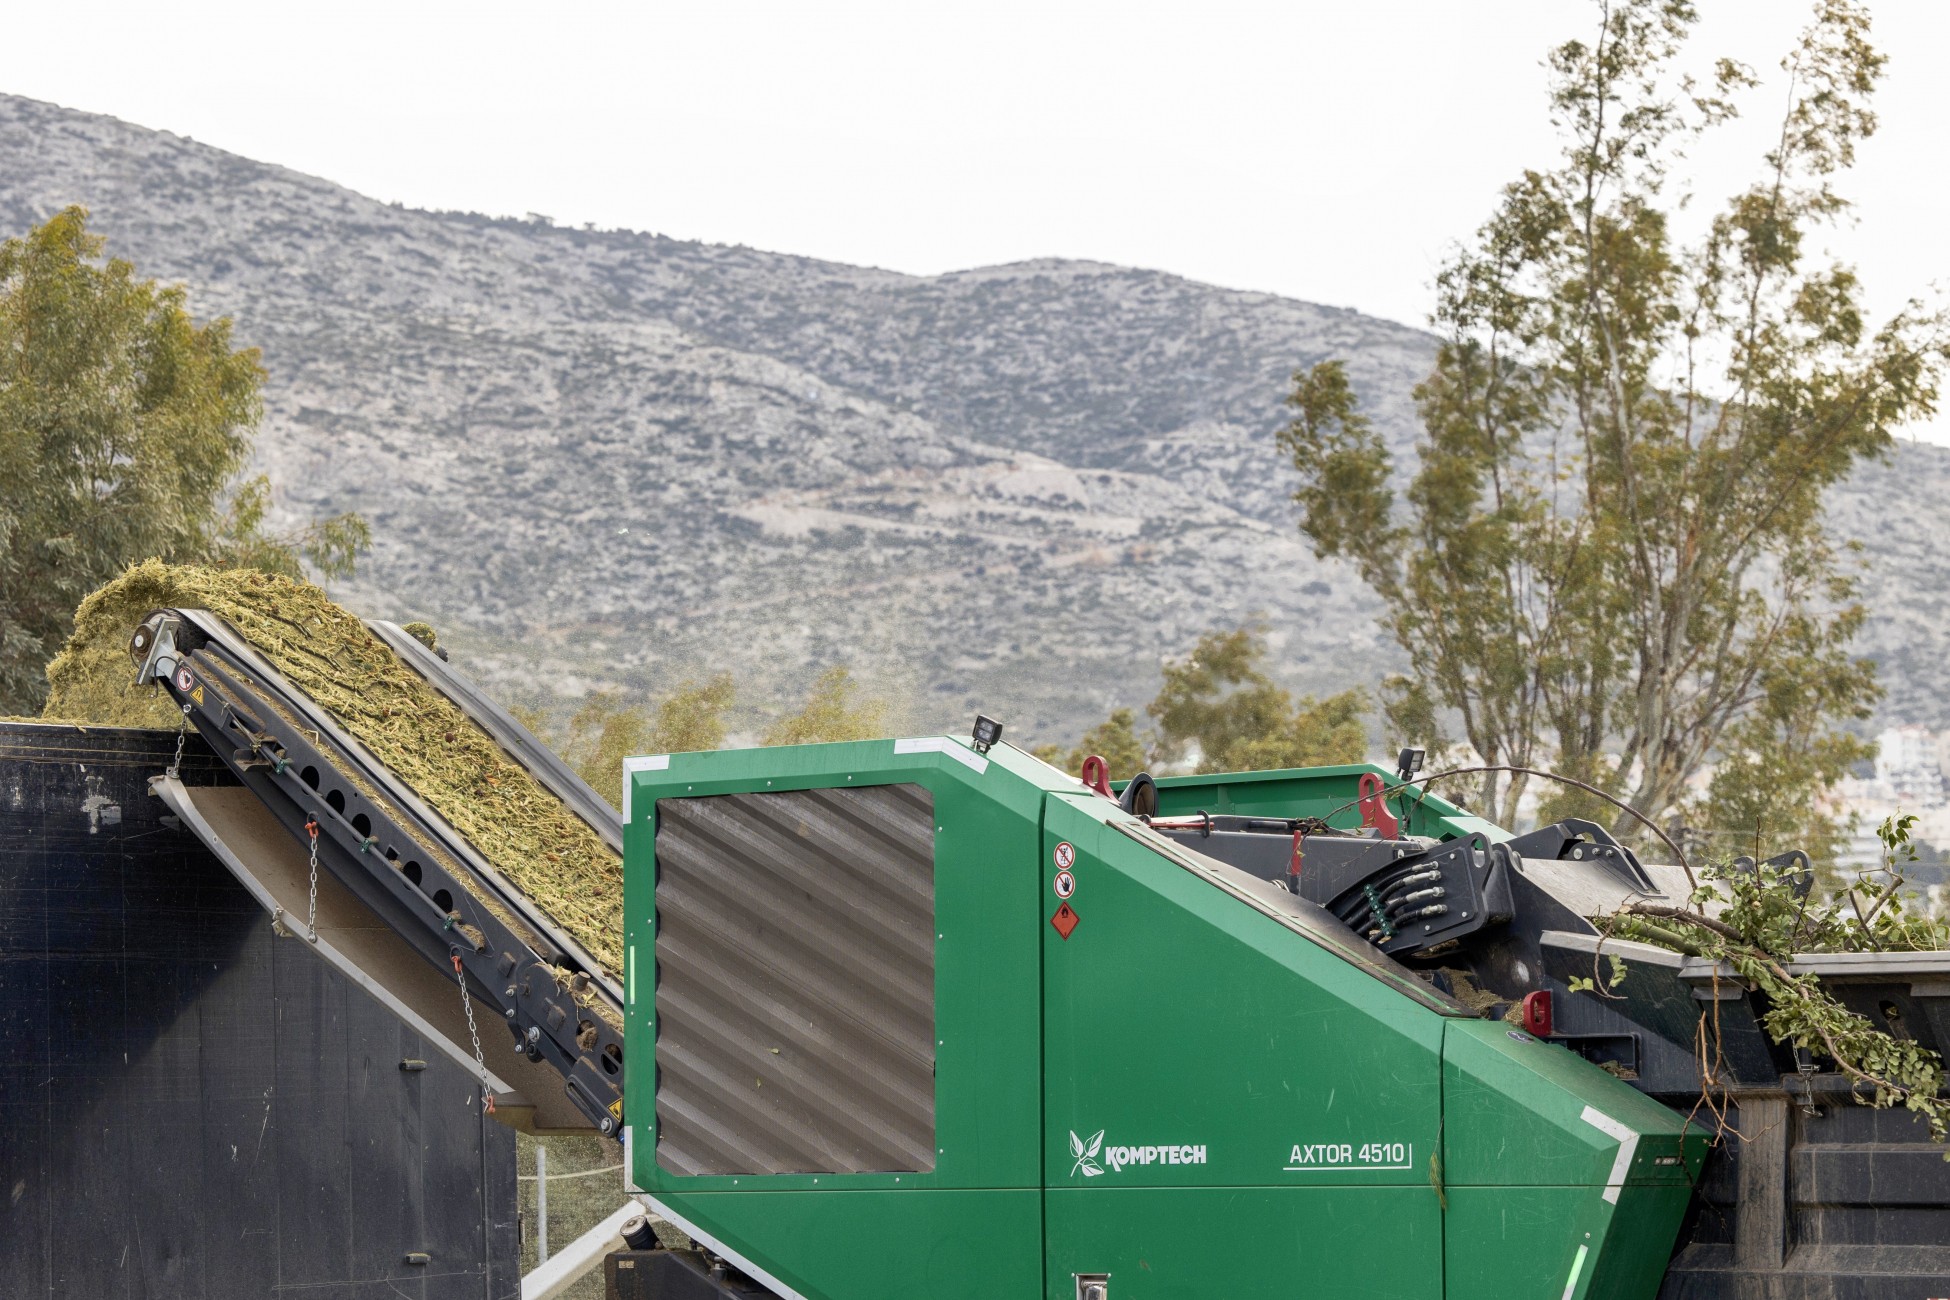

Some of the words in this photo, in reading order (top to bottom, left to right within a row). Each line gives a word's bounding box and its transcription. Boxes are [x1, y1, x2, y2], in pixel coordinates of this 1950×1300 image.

[1105, 1144, 1207, 1172] KOMPTECH
[1289, 1144, 1353, 1164] AXTOR
[1358, 1143, 1405, 1163] 4510
